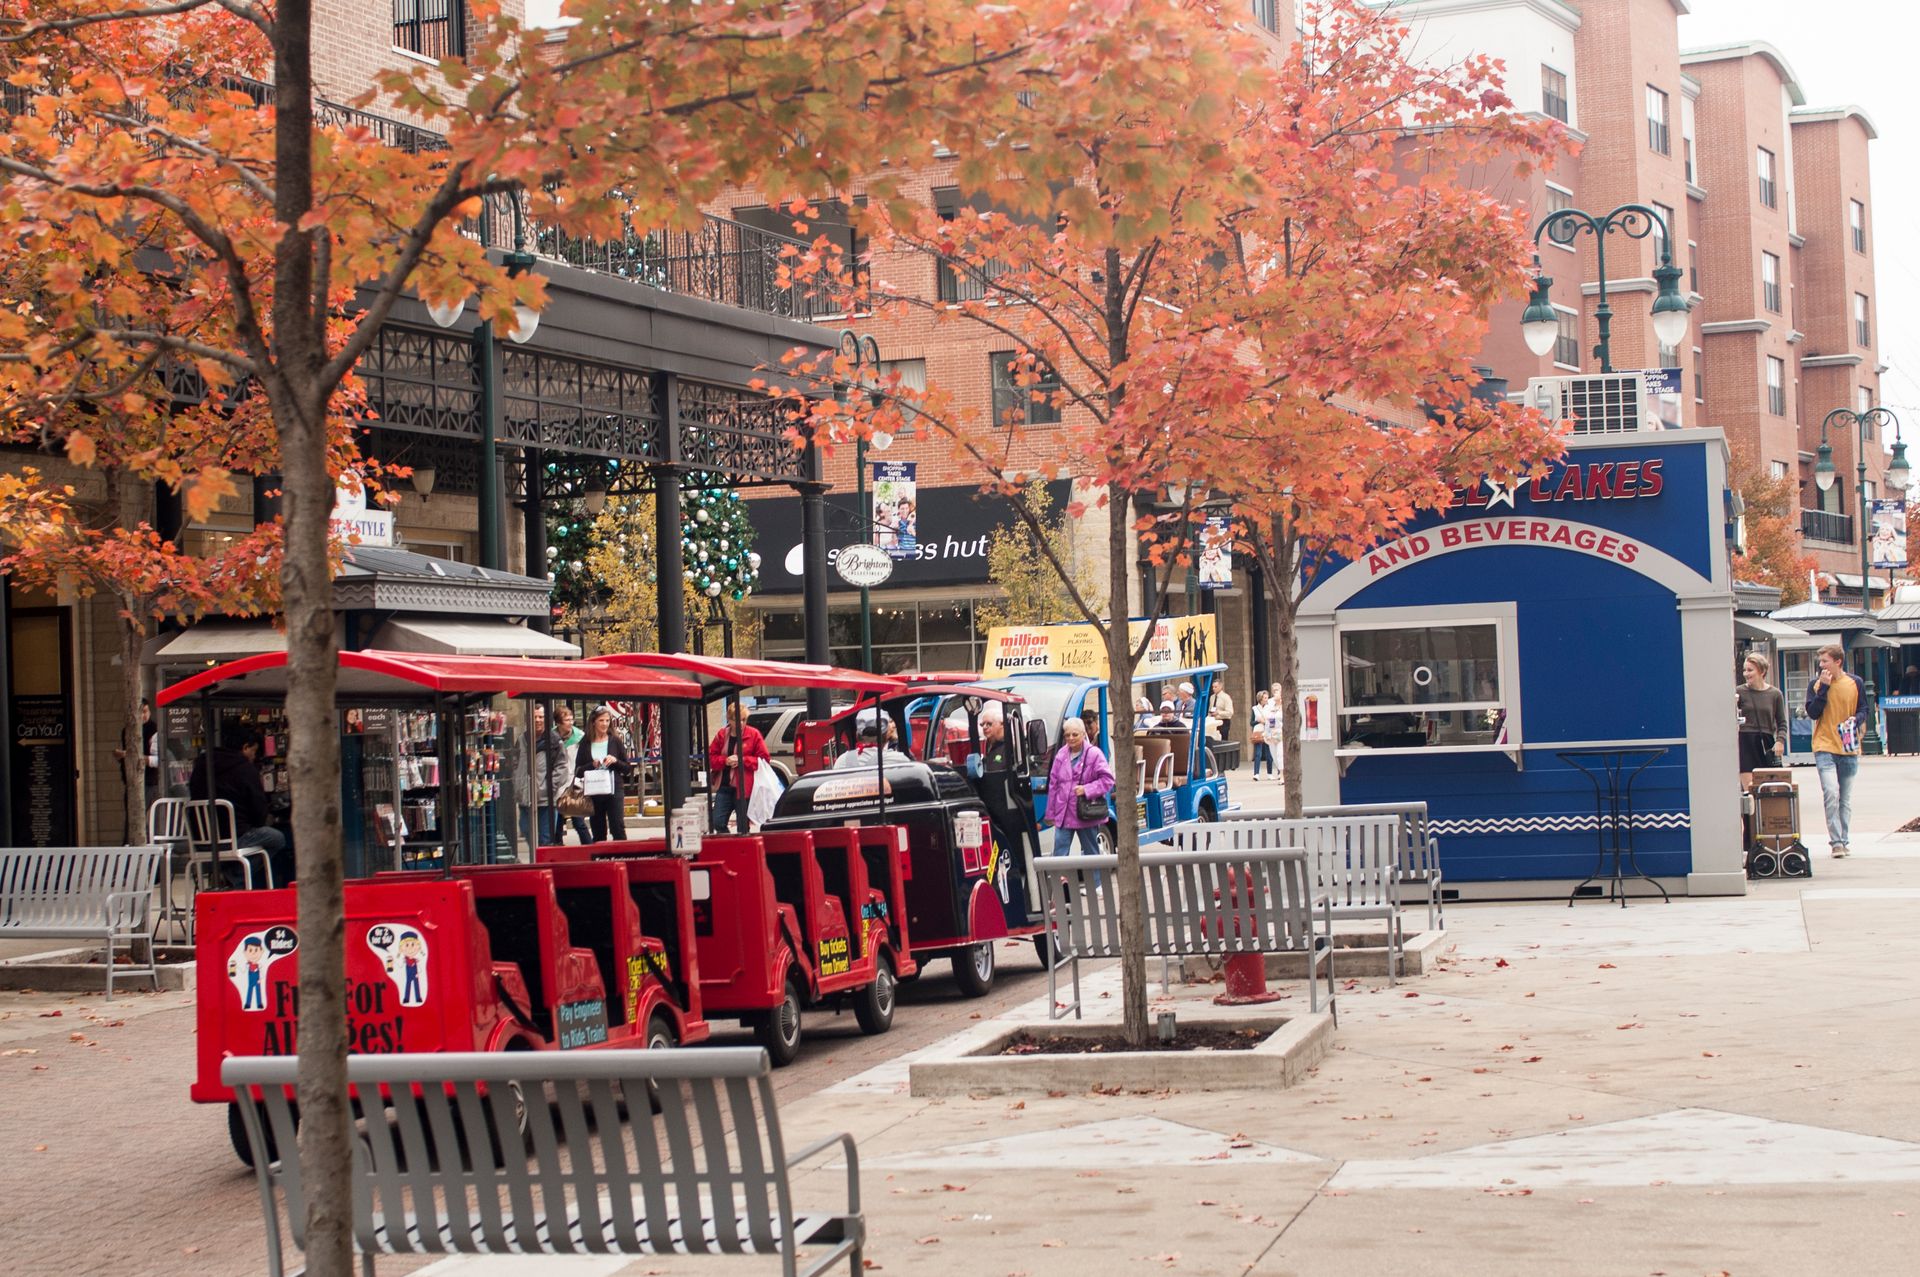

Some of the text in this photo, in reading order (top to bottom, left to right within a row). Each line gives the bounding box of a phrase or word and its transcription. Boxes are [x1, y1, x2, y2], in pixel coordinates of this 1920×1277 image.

[1529, 459, 1664, 503] CAKES
[943, 535, 989, 559] hut
[1368, 521, 1640, 576] AND BEVERAGES
[842, 552, 890, 573] Brighton
[1000, 634, 1049, 647] million
[1002, 643, 1044, 658] dollar
[995, 655, 1048, 671] quartet
[1149, 648, 1172, 662] quartet
[1885, 697, 1899, 705] THE
[367, 713, 386, 721] each
[17, 723, 63, 736] Can You?
[820, 941, 830, 959] Buy
[830, 937, 847, 955] tickets
[561, 1003, 573, 1024] Pay
[574, 998, 602, 1021] Engineer
[262, 1018, 299, 1055] Al
[562, 1023, 606, 1049] to Ride Train!
